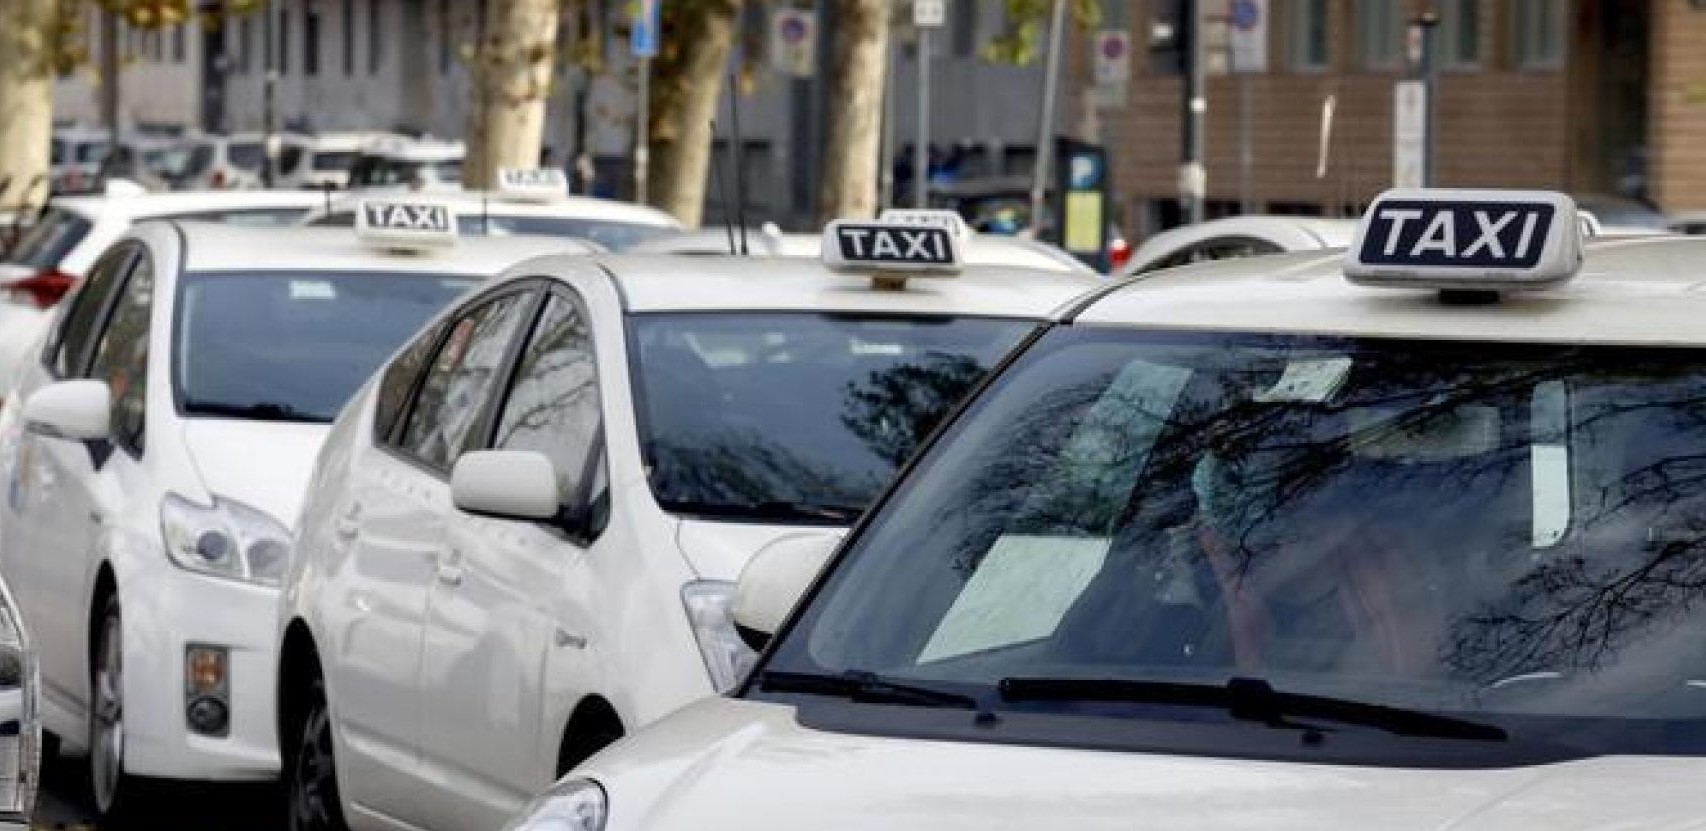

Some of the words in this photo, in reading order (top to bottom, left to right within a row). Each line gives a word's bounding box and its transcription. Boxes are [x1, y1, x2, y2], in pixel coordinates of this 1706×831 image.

[369, 205, 444, 229] TAXI
[1379, 208, 1539, 258] TAXI
[841, 228, 947, 260] TAXI
